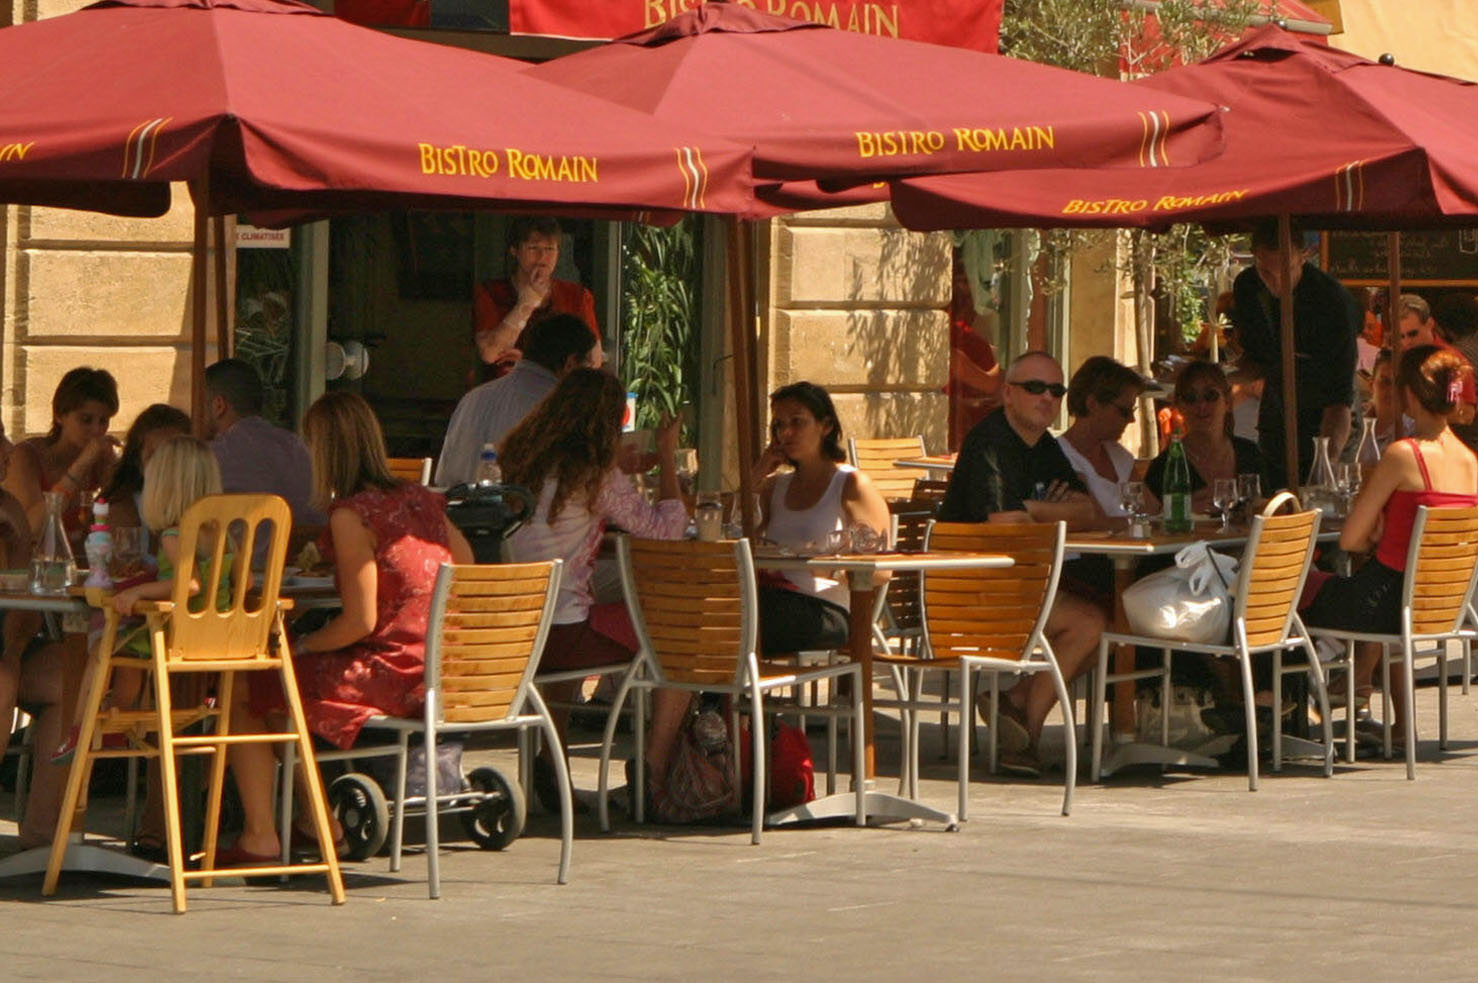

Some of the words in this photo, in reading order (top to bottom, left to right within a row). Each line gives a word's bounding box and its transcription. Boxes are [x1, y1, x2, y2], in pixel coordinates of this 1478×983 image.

[857, 130, 945, 158] BISTRO
[953, 125, 1054, 152] ROMAIN
[418, 142, 499, 178] BISTRO
[505, 148, 599, 183] ROMAIN
[1062, 199, 1148, 214] BISTRO
[1152, 188, 1249, 212] ROMAIN
